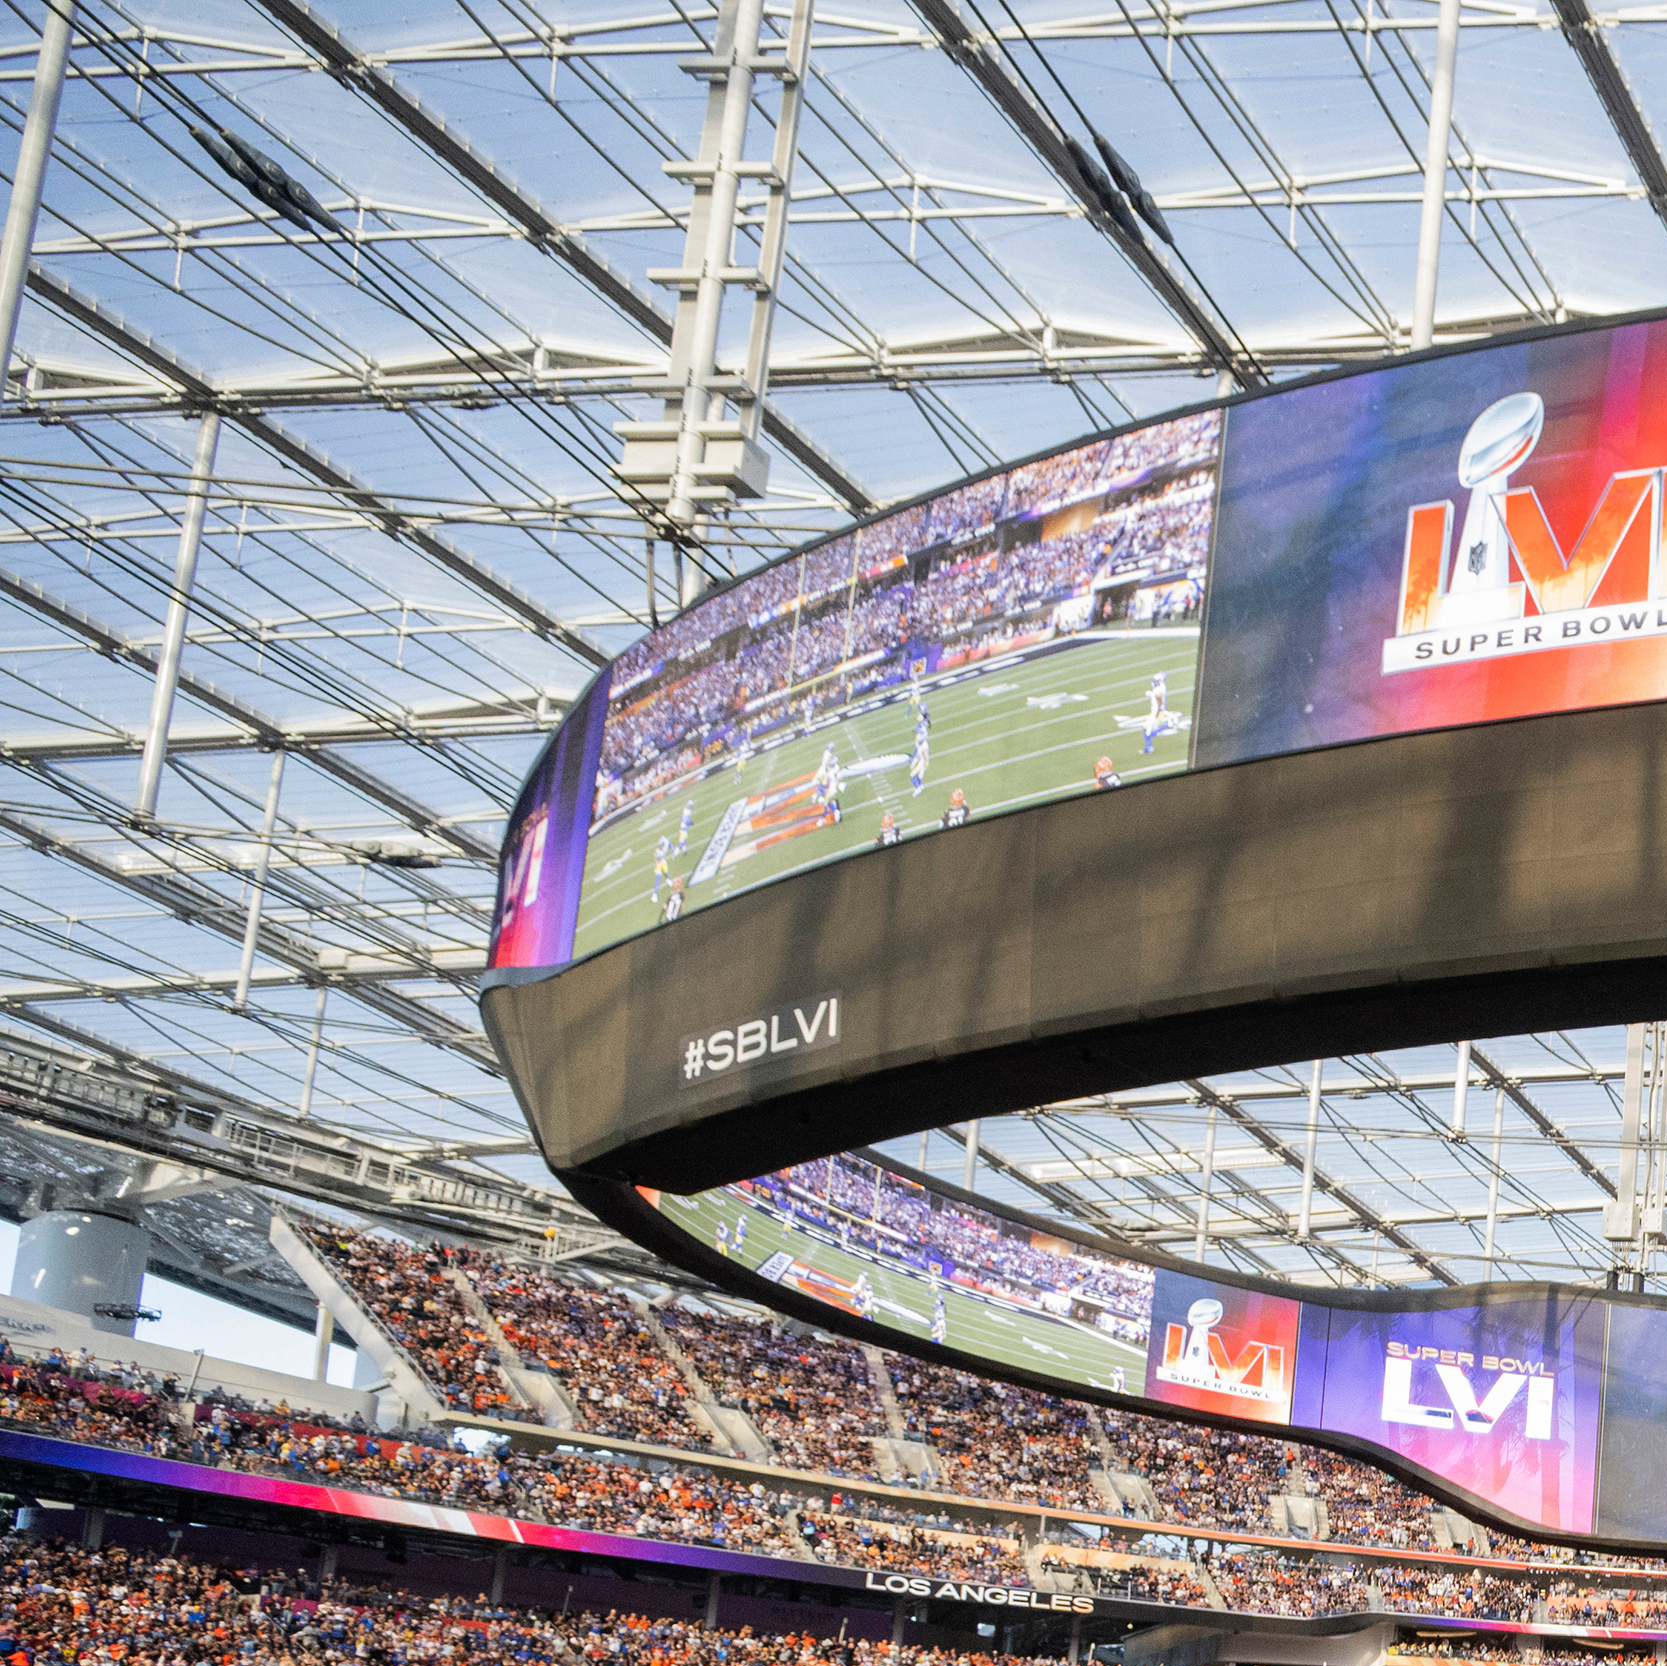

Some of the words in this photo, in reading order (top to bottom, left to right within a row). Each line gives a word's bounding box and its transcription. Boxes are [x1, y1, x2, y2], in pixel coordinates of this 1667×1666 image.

[1414, 623, 1544, 659] SUPER
[683, 998, 839, 1079] #SBLVI
[1386, 1340, 1475, 1366] SUPER
[1482, 1355, 1555, 1377] BOWL
[1169, 1374, 1223, 1391] SUPER
[1229, 1384, 1273, 1400] BOWL
[1382, 1357, 1555, 1441] LVI
[866, 1572, 931, 1597] LOS
[934, 1583, 1095, 1614] ANGELES
